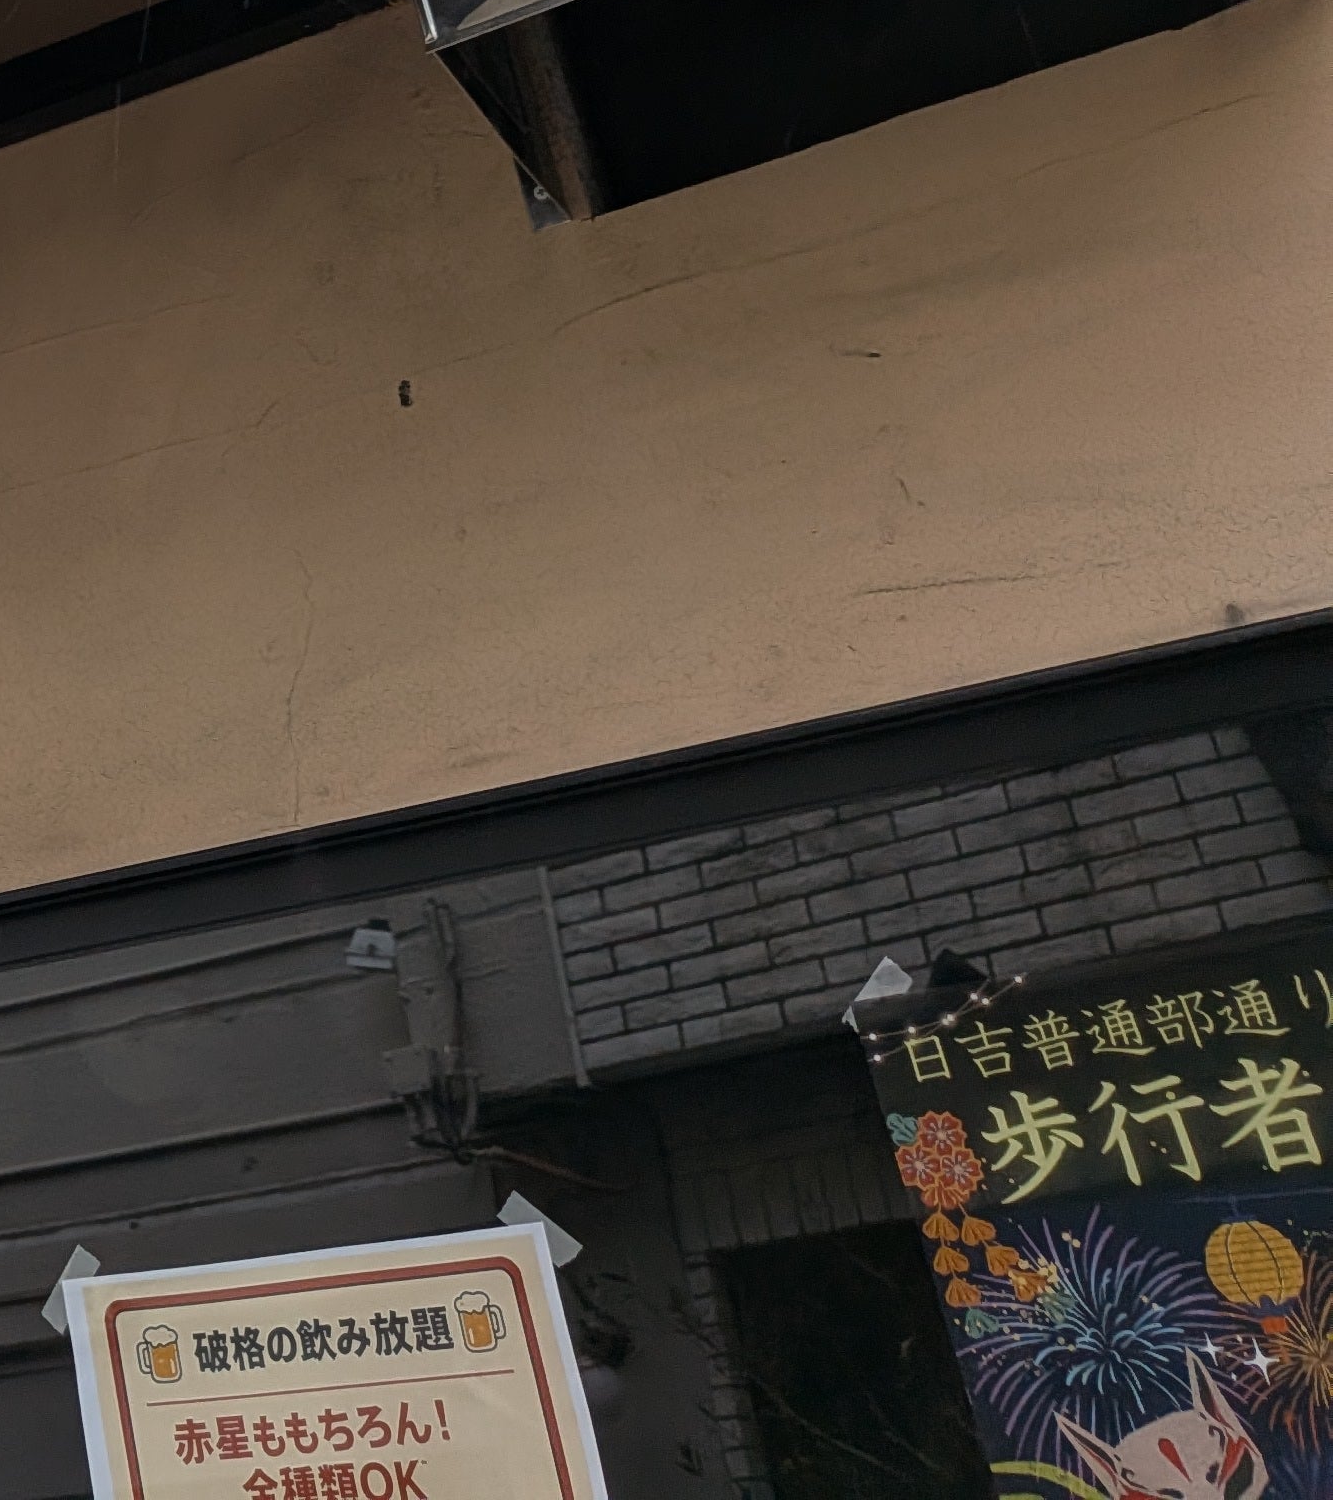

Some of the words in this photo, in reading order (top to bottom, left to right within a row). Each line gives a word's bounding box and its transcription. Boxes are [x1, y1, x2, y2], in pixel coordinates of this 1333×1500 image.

[903, 968, 1333, 1084] 日吉普通部通り
[980, 1056, 1325, 1205] 歩行者
[192, 1305, 456, 1375] 破格の飲み放題
